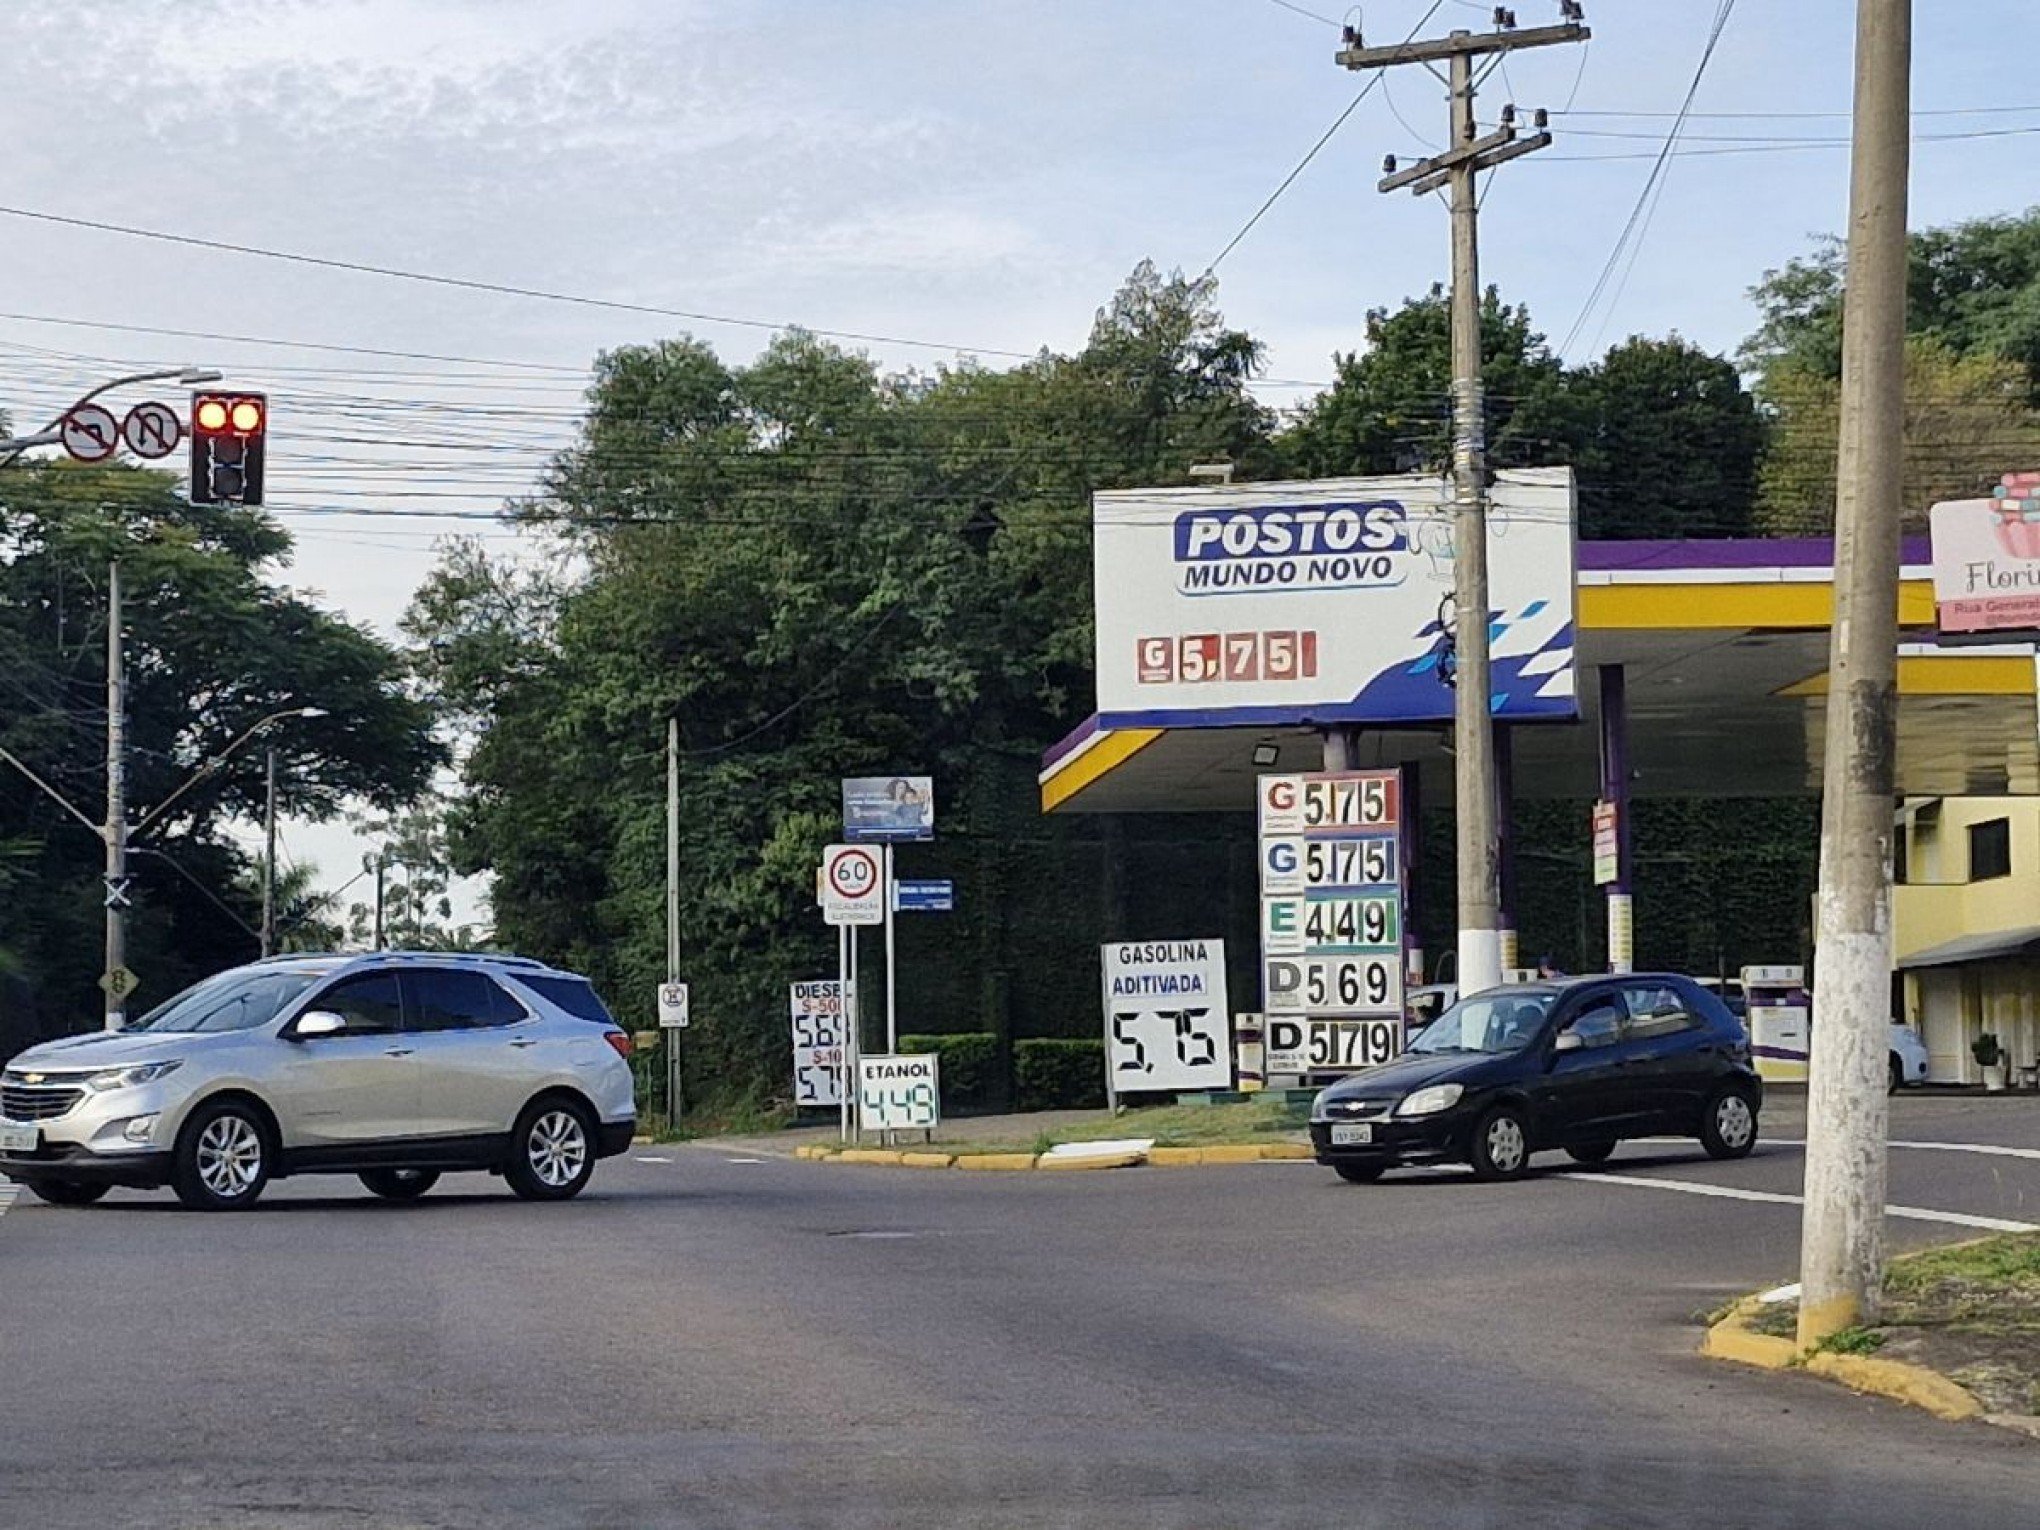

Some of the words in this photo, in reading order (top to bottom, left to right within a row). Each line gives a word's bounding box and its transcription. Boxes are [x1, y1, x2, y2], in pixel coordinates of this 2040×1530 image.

[1187, 507, 1399, 558] POSTOS
[1184, 561, 1297, 588] MUNDO
[1308, 555, 1392, 582] NOVO
[1954, 602, 1981, 613] Rua
[1144, 640, 1166, 667] G
[1267, 782, 1296, 810] G
[838, 861, 867, 881] 60
[1267, 842, 1297, 873] G
[1270, 902, 1296, 932] E
[1119, 942, 1208, 965] GASOLINA
[1113, 973, 1203, 995] ADITIVADA
[1268, 961, 1301, 992] D
[1113, 1007, 1217, 1074] 5,75
[1270, 1022, 1303, 1051] D
[866, 1064, 931, 1080] ETANOL
[864, 1083, 934, 1127] 4,49
